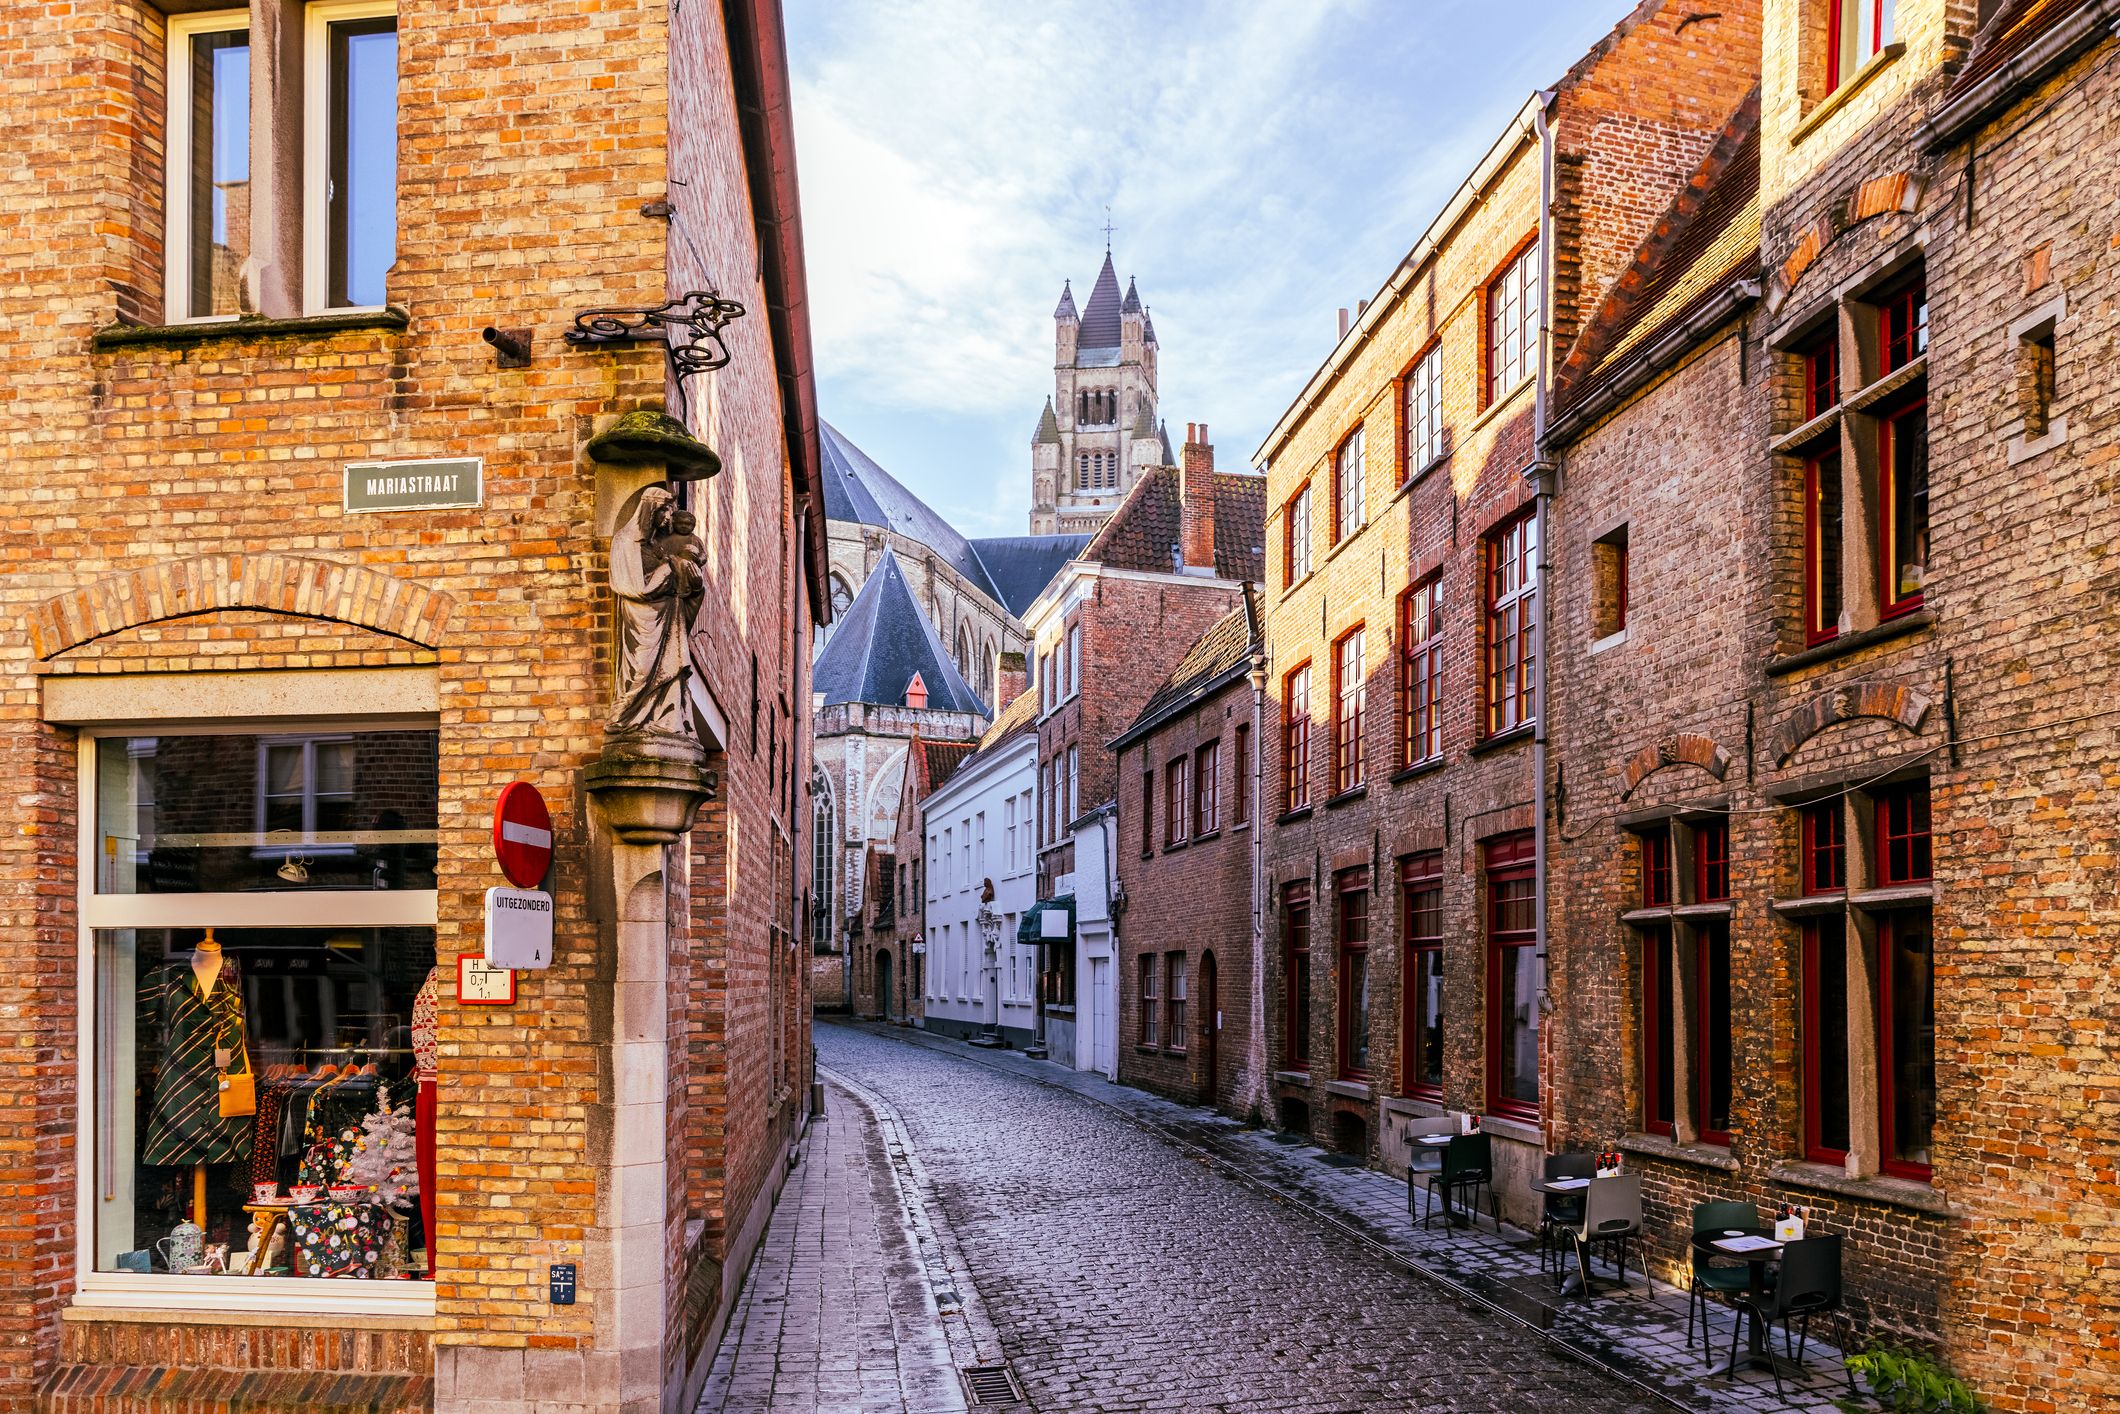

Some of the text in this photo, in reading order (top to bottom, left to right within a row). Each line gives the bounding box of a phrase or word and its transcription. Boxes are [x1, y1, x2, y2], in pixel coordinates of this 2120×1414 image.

[367, 475, 458, 495] MARIASTRAAT
[497, 896, 550, 912] UITGEZONDERD
[534, 949, 540, 961] A
[472, 959, 479, 970] H
[551, 1270, 560, 1278] SA
